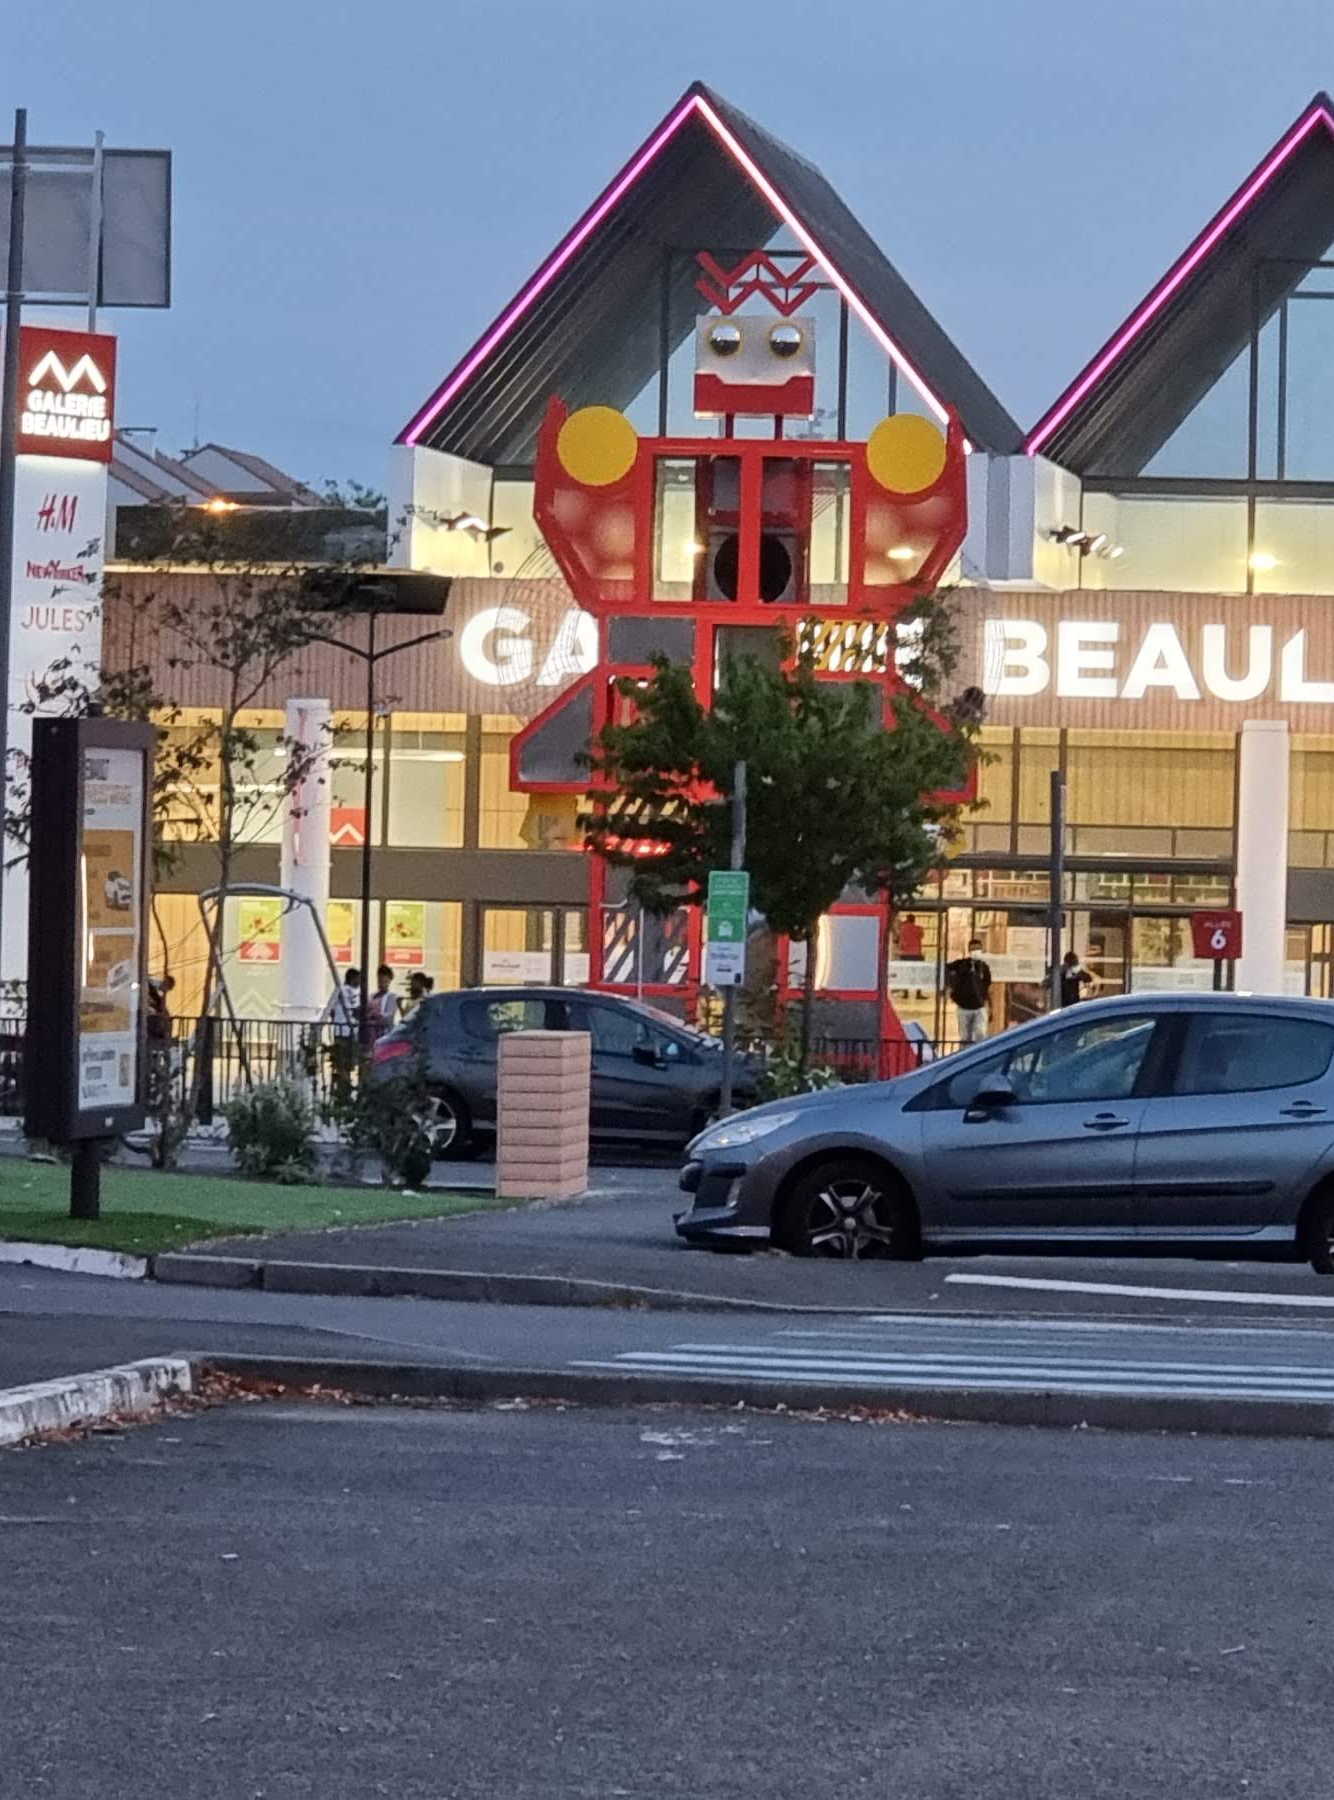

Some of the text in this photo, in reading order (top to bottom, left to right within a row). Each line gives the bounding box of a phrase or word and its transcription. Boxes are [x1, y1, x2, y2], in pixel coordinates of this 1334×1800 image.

[27, 390, 107, 418] GALERIE
[21, 412, 111, 442] BEAULIEU
[21, 606, 86, 632] JULES
[1211, 929, 1226, 950] 6
